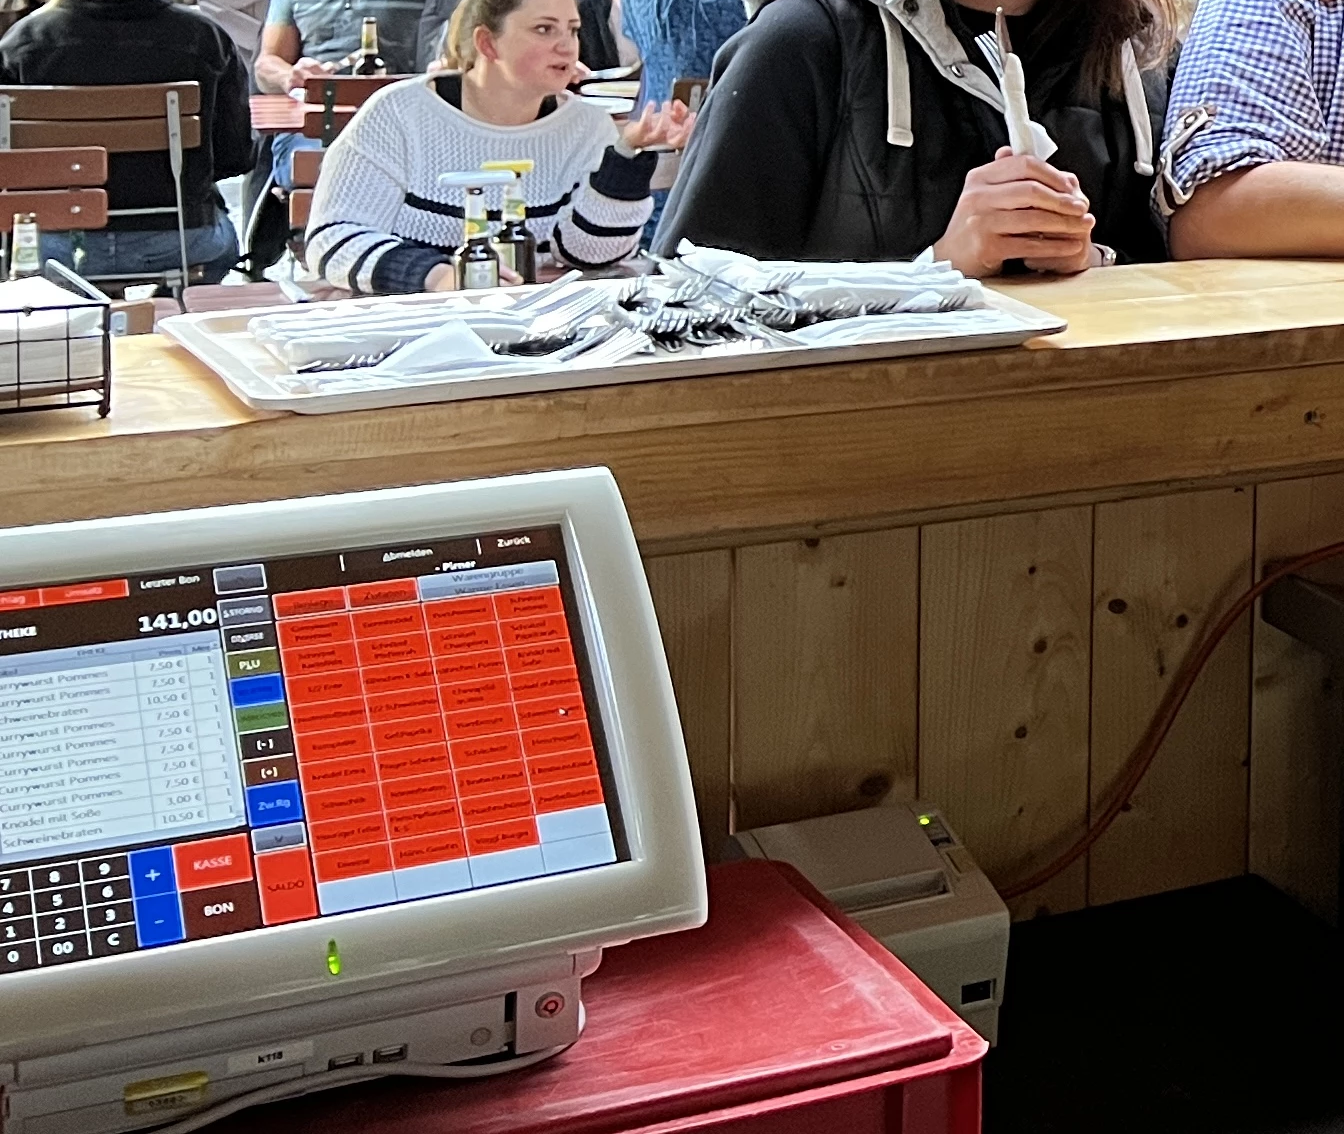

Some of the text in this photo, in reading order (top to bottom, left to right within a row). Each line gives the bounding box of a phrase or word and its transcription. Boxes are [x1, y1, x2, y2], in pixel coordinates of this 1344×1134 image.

[497, 535, 532, 548] Zurück
[382, 548, 434, 563] Abmelden
[140, 574, 200, 590] Letzter Bon
[451, 567, 525, 583] Warengruppe
[138, 607, 218, 634] 141,00
[58, 670, 109, 683] Pommes
[60, 687, 111, 700] Pommes
[0, 707, 89, 723] chweinebraten
[63, 720, 115, 734] Pommes
[65, 737, 117, 751] Pommes
[67, 754, 119, 769] Pommes
[69, 771, 121, 786] Pommes
[0, 796, 67, 813] Currywurst
[71, 789, 123, 804] Pommes
[48, 813, 67, 824] mit
[71, 808, 101, 820] Soße
[3, 826, 103, 850] Schweinebraten
[193, 855, 233, 871] KASSE
[0, 877, 11, 891] 7
[49, 870, 61, 883] 8
[98, 863, 111, 875] 9
[2, 886, 114, 914] 4 5 6
[203, 902, 235, 917] BON
[5, 926, 17, 938] 1
[54, 917, 66, 930] 2
[104, 908, 117, 921] 3
[7, 933, 120, 964] 0 00 C
